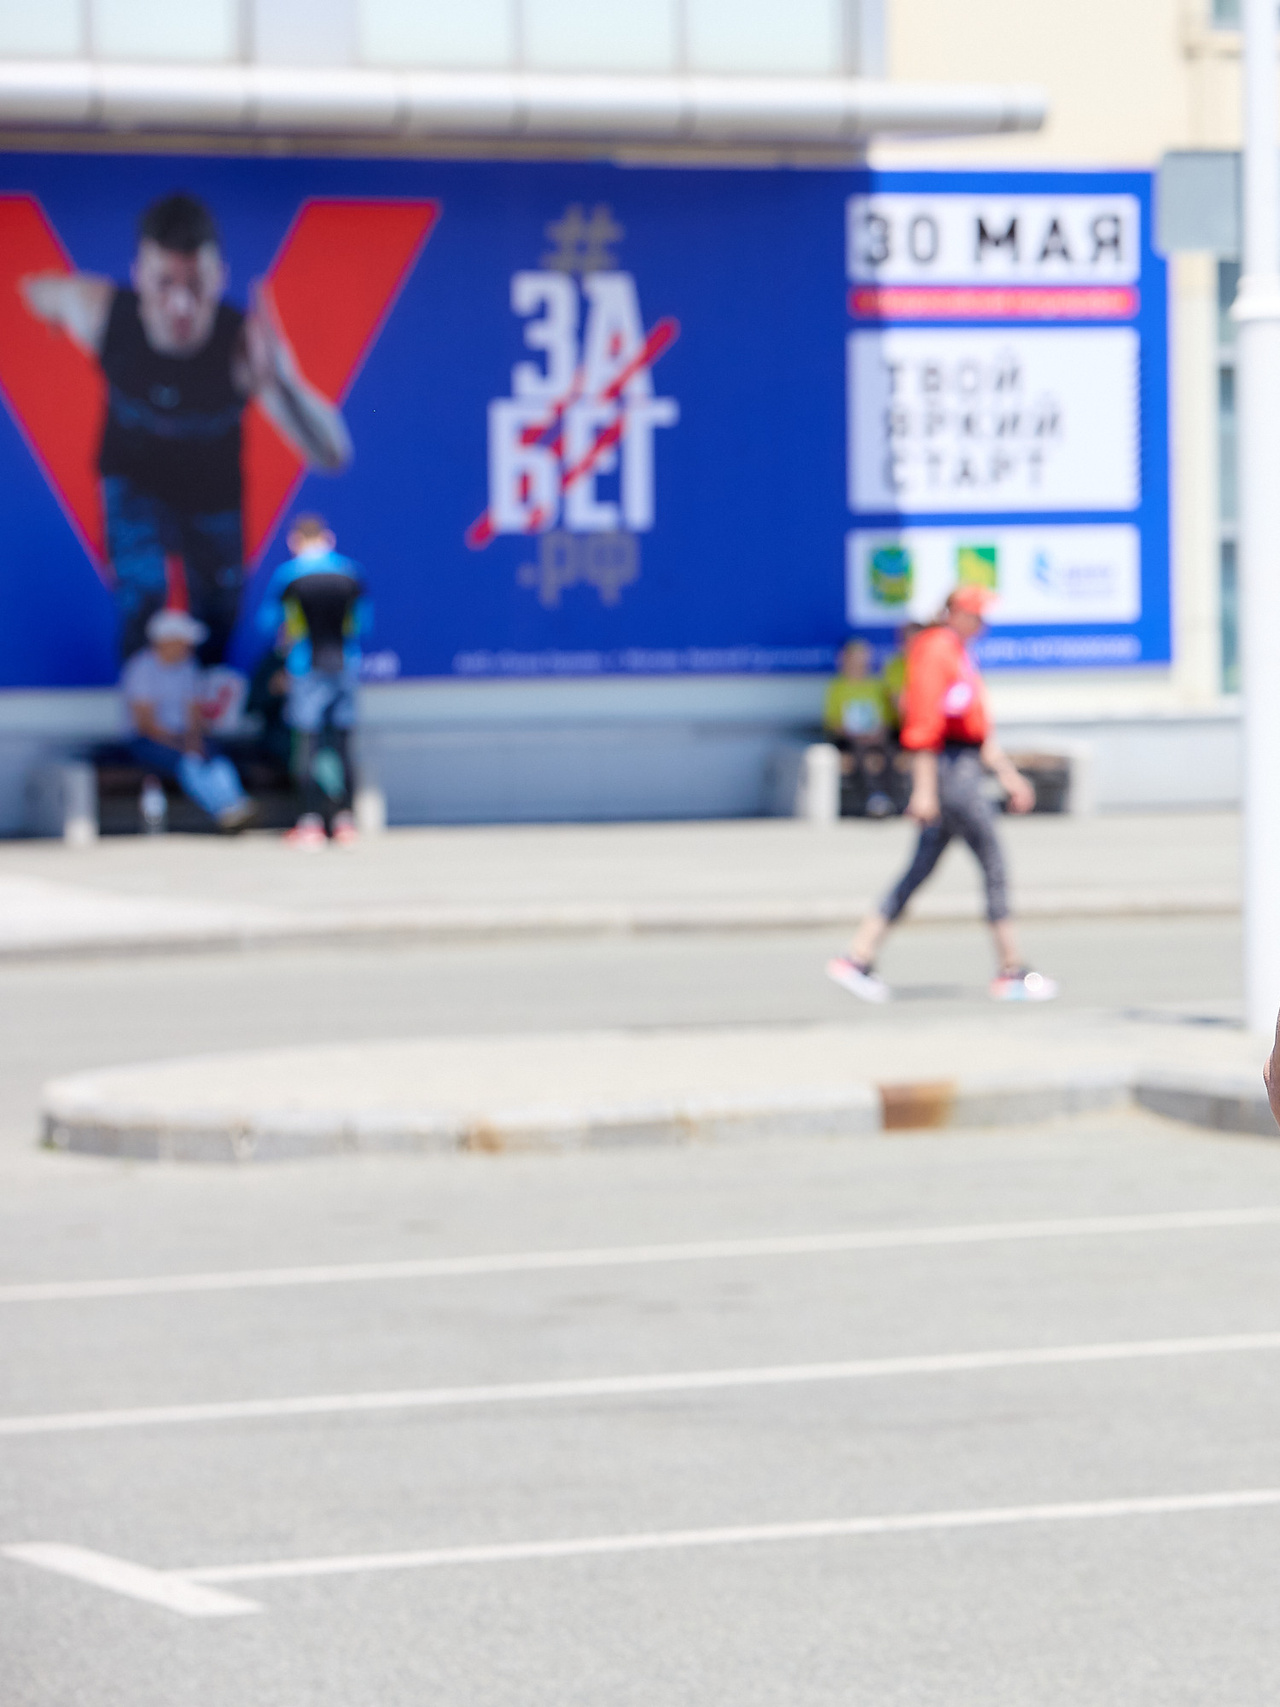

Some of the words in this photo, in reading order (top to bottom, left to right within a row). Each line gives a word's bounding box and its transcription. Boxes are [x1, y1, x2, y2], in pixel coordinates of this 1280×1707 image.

[864, 211, 940, 267] 30
[973, 213, 1124, 265] МАЯ
[882, 348, 1022, 394] ТВОЙ
[880, 394, 1063, 441] ЯРКИЙ
[880, 448, 1046, 493] СТАРТ
